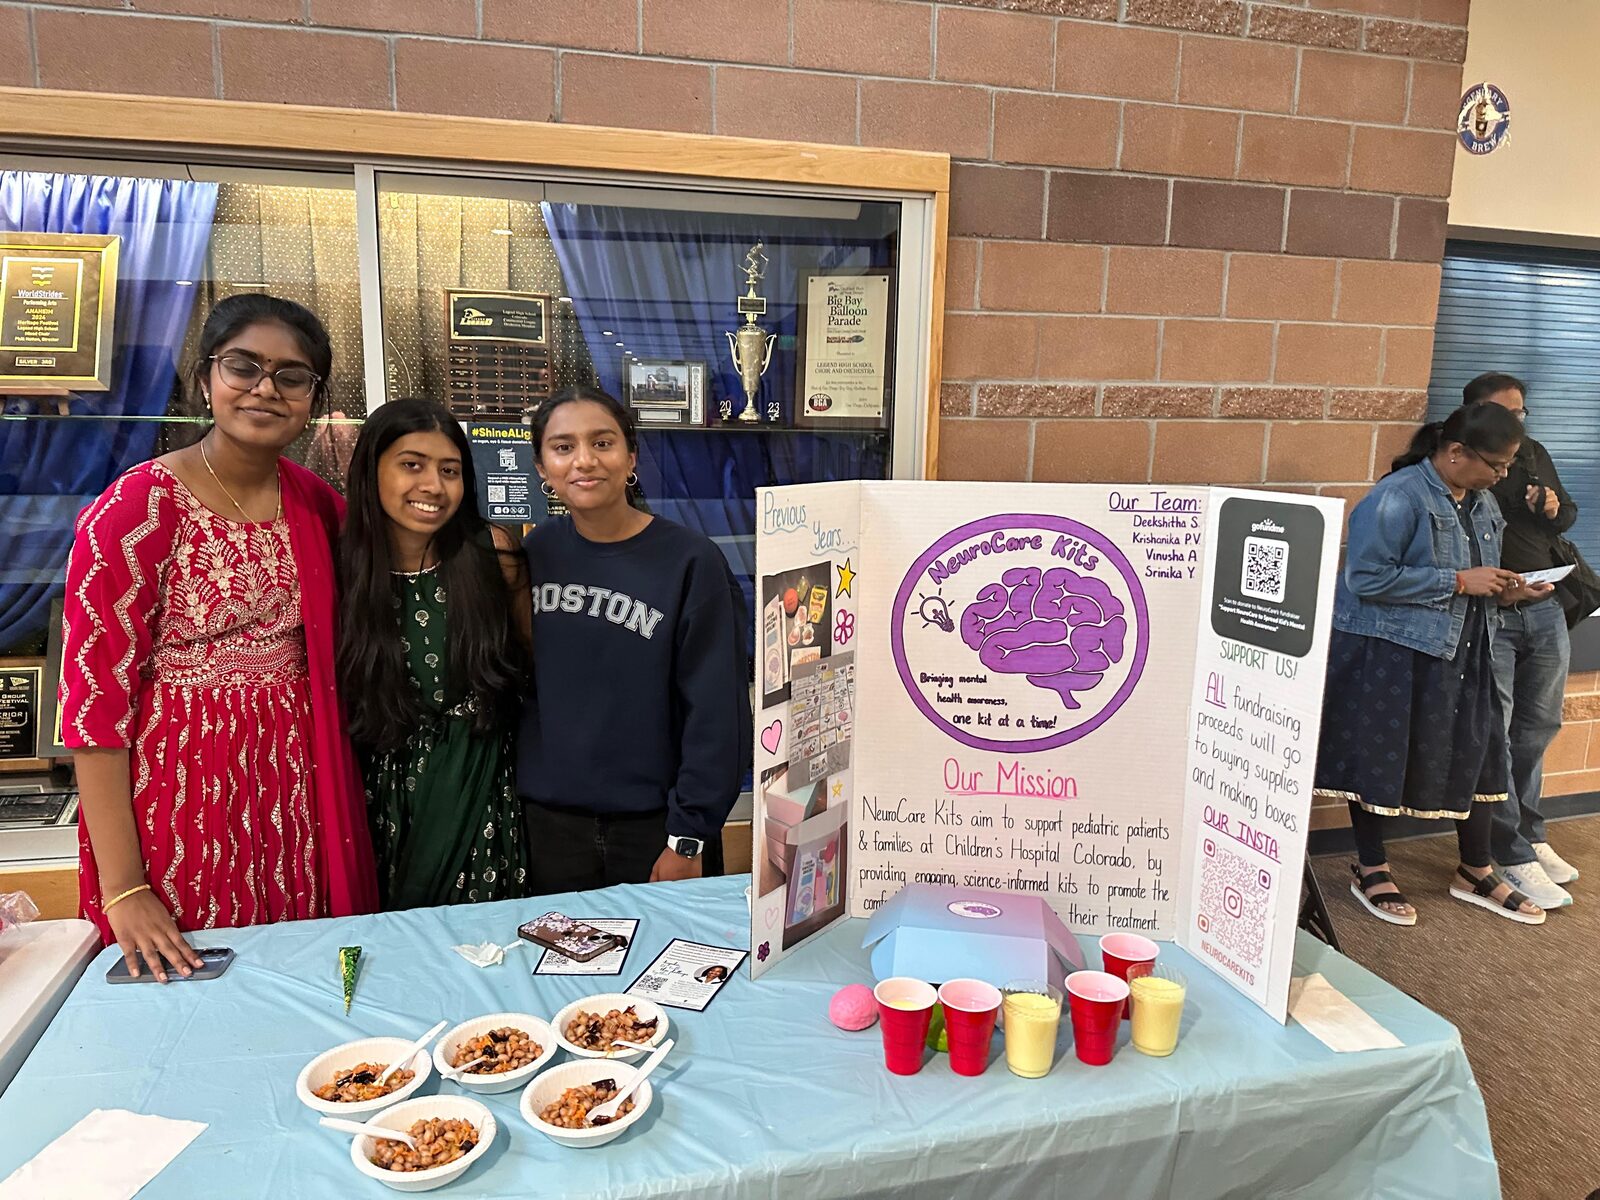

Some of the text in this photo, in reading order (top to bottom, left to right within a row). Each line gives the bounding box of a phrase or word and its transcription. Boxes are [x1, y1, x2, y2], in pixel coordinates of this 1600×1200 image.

[1471, 133, 1497, 152] BREW
[18, 289, 63, 298] WorldStrides
[827, 295, 863, 308] Big Bay
[828, 315, 861, 326] Parade
[830, 306, 868, 316] Balloon
[472, 427, 531, 440] #ShineALig
[764, 491, 807, 529] Previous
[1109, 491, 1202, 511] Our Team:
[1133, 514, 1186, 528] Deekshitha
[1251, 521, 1285, 534] gofundme
[1132, 532, 1180, 544] Krishanika
[928, 532, 1099, 585] NeuroCare Kits
[1146, 548, 1184, 561] Vinusha
[1145, 565, 1182, 579] Srinika
[1220, 640, 1298, 680] SUPPORT US!
[920, 672, 987, 688] Bringing mental
[937, 692, 962, 704] health
[953, 713, 1057, 729] one kit at a time!
[1233, 685, 1301, 741] fundraising
[1197, 712, 1301, 769] proceeds will go
[1195, 734, 1299, 795] to buying supplies
[944, 758, 1077, 798] Our Mission
[1192, 767, 1298, 833] and making boxes.
[862, 795, 1170, 843] NeuroCare Kits aim to support pediatric patients
[1203, 805, 1279, 858] OUR INSTA
[858, 830, 1162, 876] & families at Children's Hospital Colorado, by
[859, 861, 906, 888] providing
[963, 869, 1049, 892] science-informed
[1057, 872, 1078, 894] kits
[1088, 874, 1100, 895] to
[1107, 878, 1146, 902] promote
[1151, 879, 1170, 901] the
[1068, 903, 1099, 925] their
[1106, 906, 1160, 931] treatment.
[1201, 939, 1255, 987] NEUROCAREKITS
